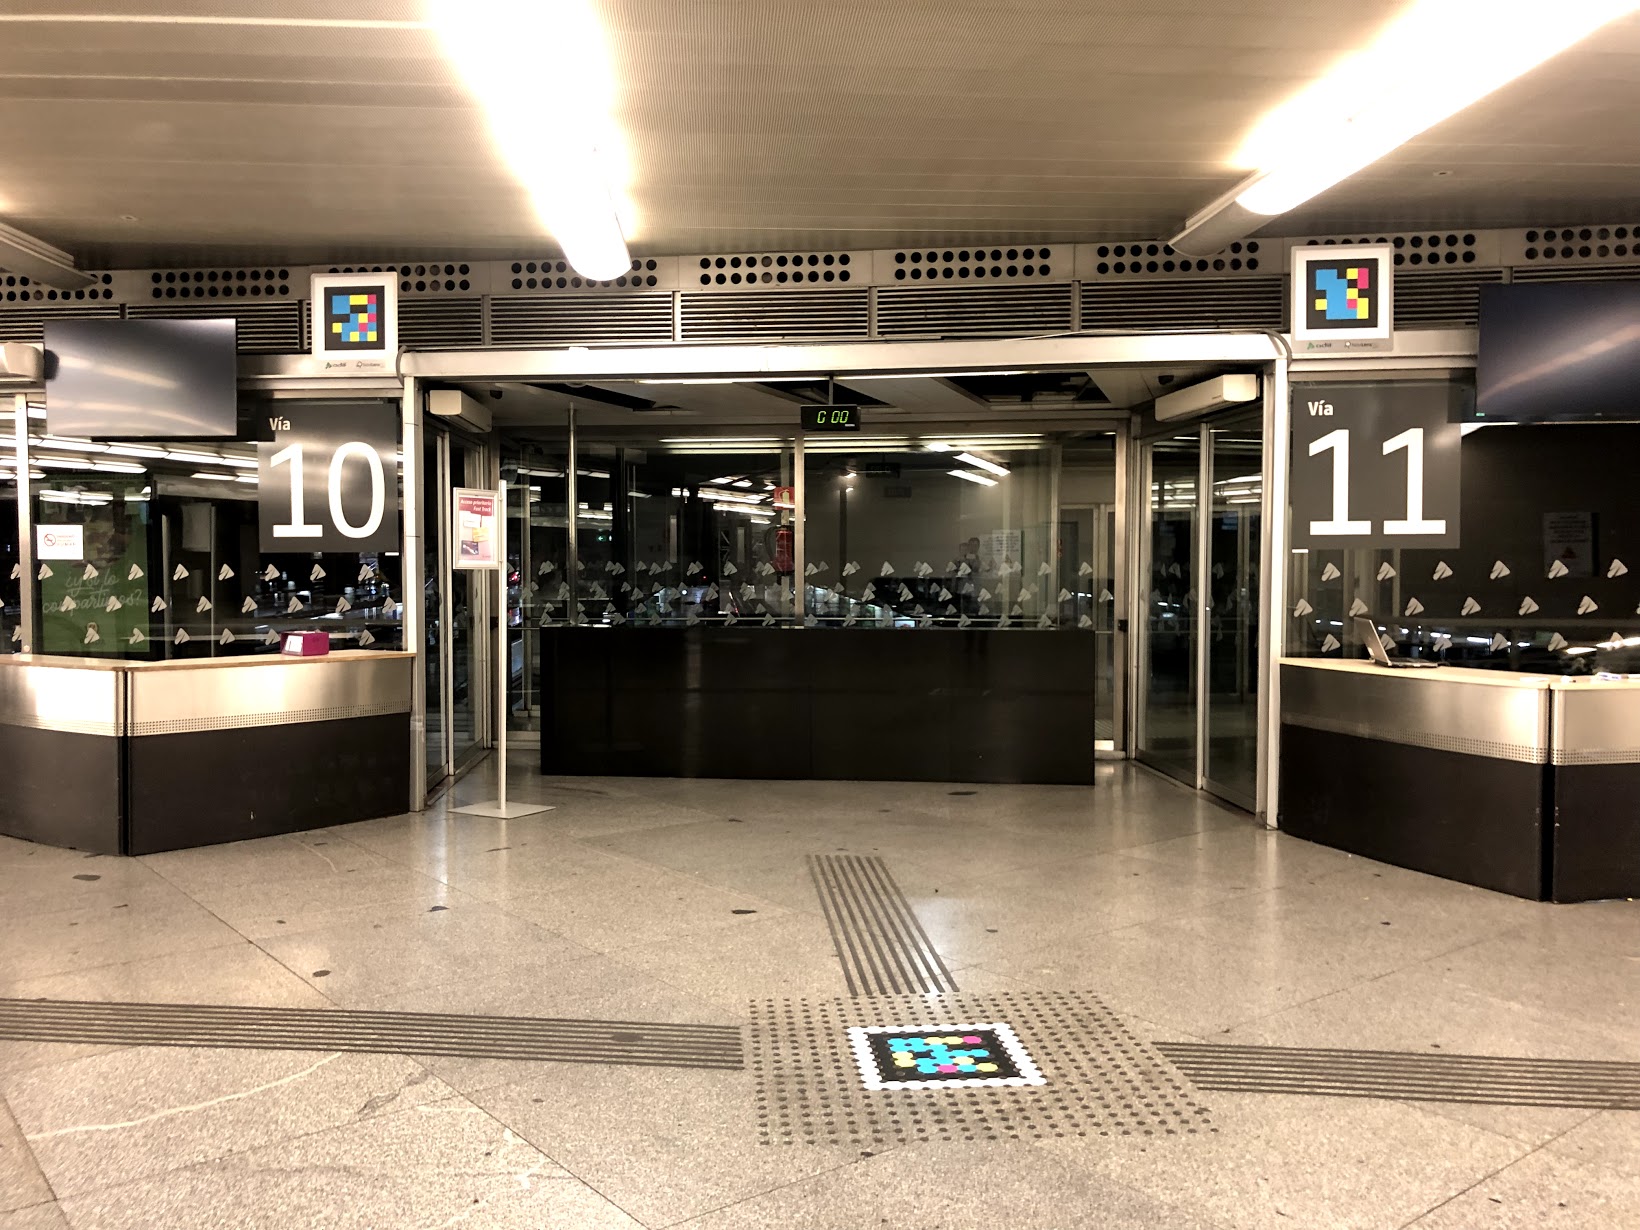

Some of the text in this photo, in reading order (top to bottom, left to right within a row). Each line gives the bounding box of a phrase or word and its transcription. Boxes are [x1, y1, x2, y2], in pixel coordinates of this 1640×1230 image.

[269, 416, 291, 431] Vía
[1308, 400, 1334, 416] Vía
[270, 441, 386, 539] 10
[1308, 427, 1446, 536] 11
[42, 585, 142, 617] copartios?
